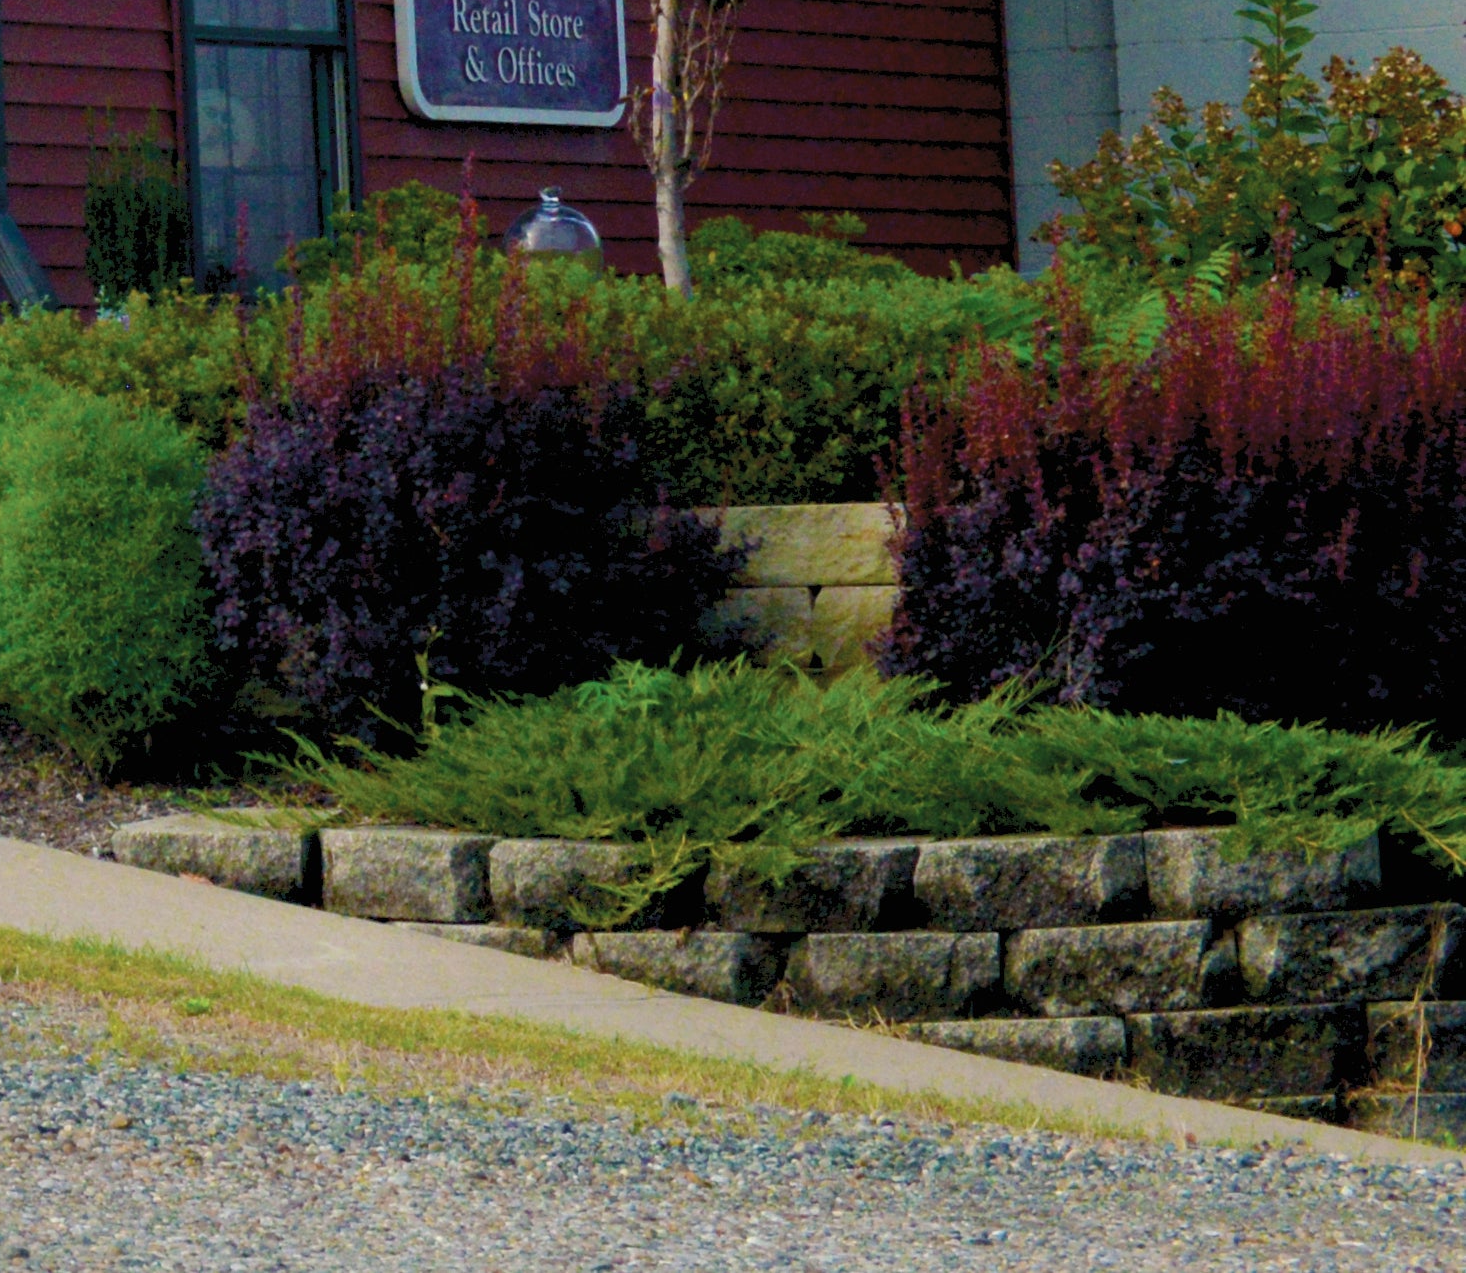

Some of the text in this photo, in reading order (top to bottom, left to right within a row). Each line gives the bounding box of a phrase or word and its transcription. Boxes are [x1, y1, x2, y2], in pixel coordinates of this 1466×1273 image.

[528, 0, 584, 39] Store
[464, 44, 577, 88] & Offices
